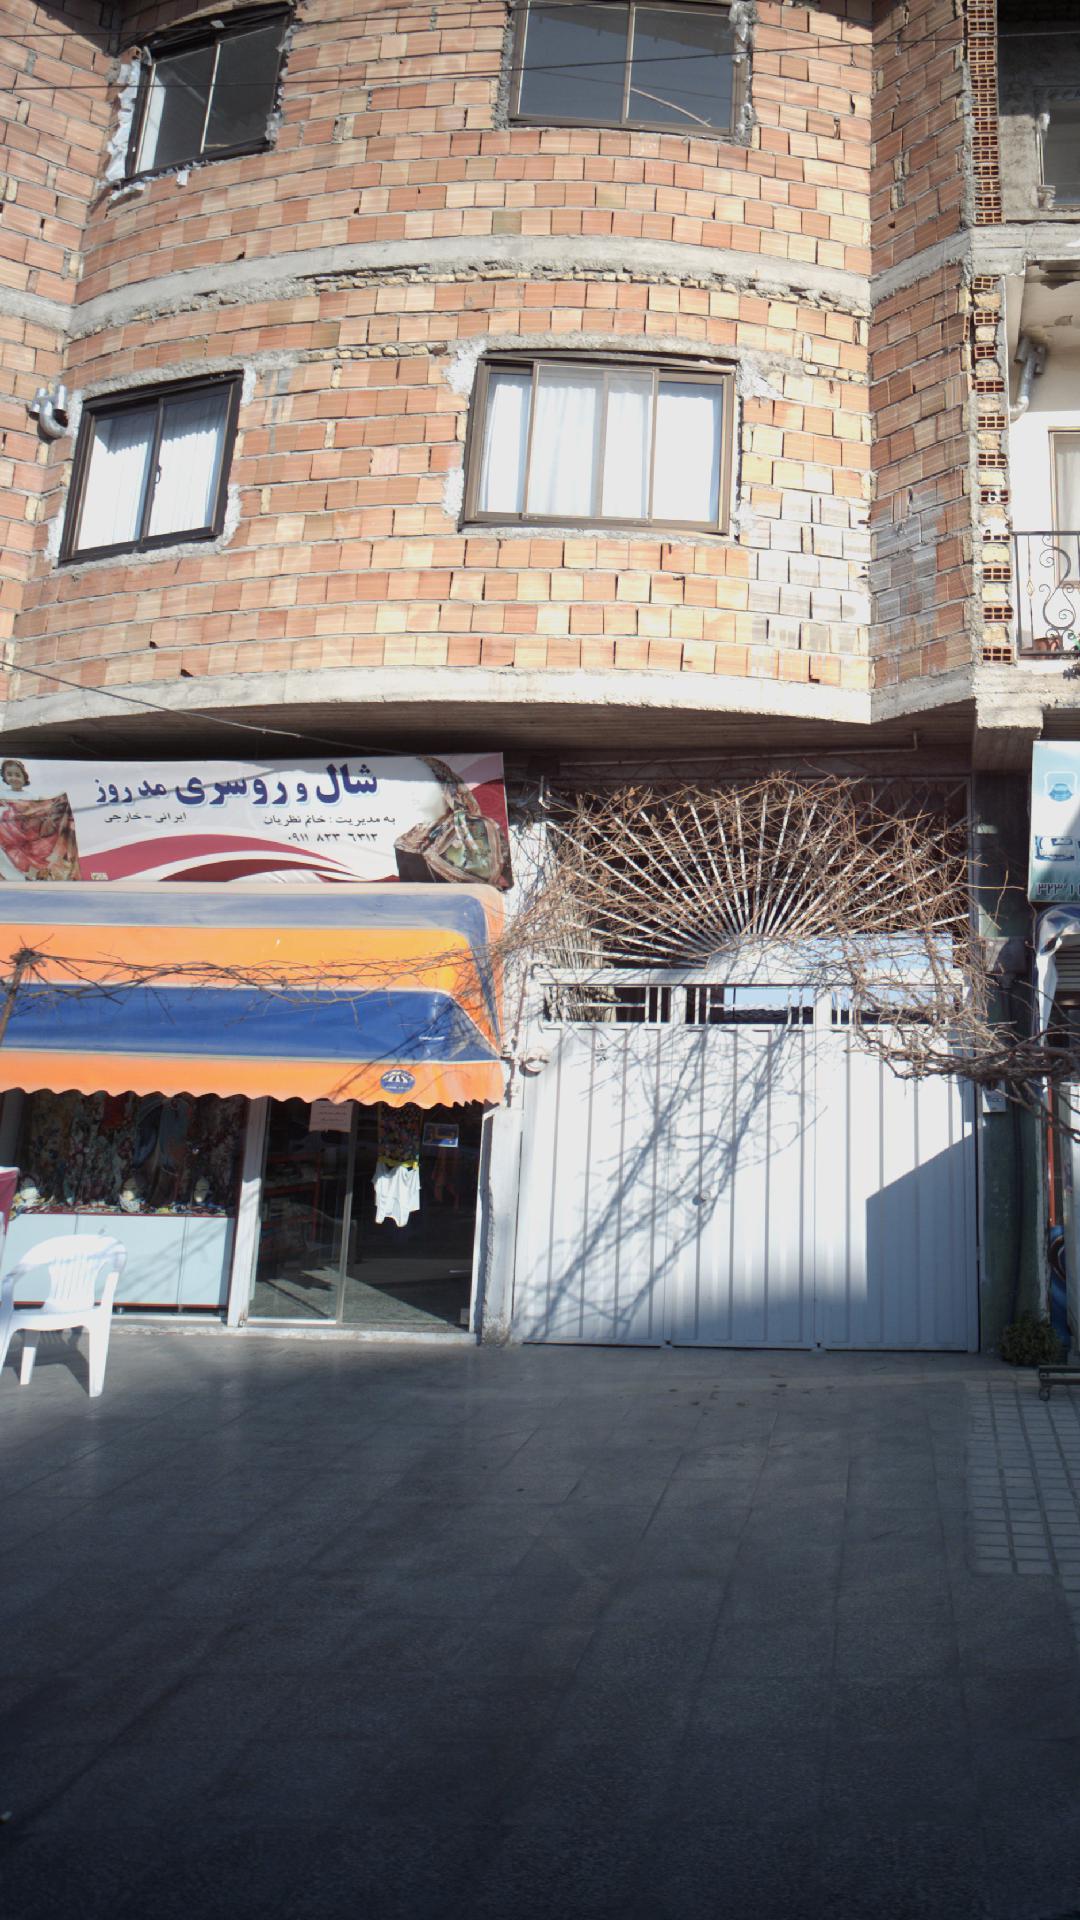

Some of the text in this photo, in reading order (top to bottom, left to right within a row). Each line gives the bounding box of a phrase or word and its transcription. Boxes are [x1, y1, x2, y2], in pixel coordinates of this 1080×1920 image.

[316, 763, 378, 803] شال
[176, 776, 287, 805] روسری
[297, 782, 308, 802] و
[104, 811, 142, 824] خارجی
[155, 811, 187, 824] ایرانی
[304, 814, 326, 828] خانم
[384, 816, 396, 825] به
